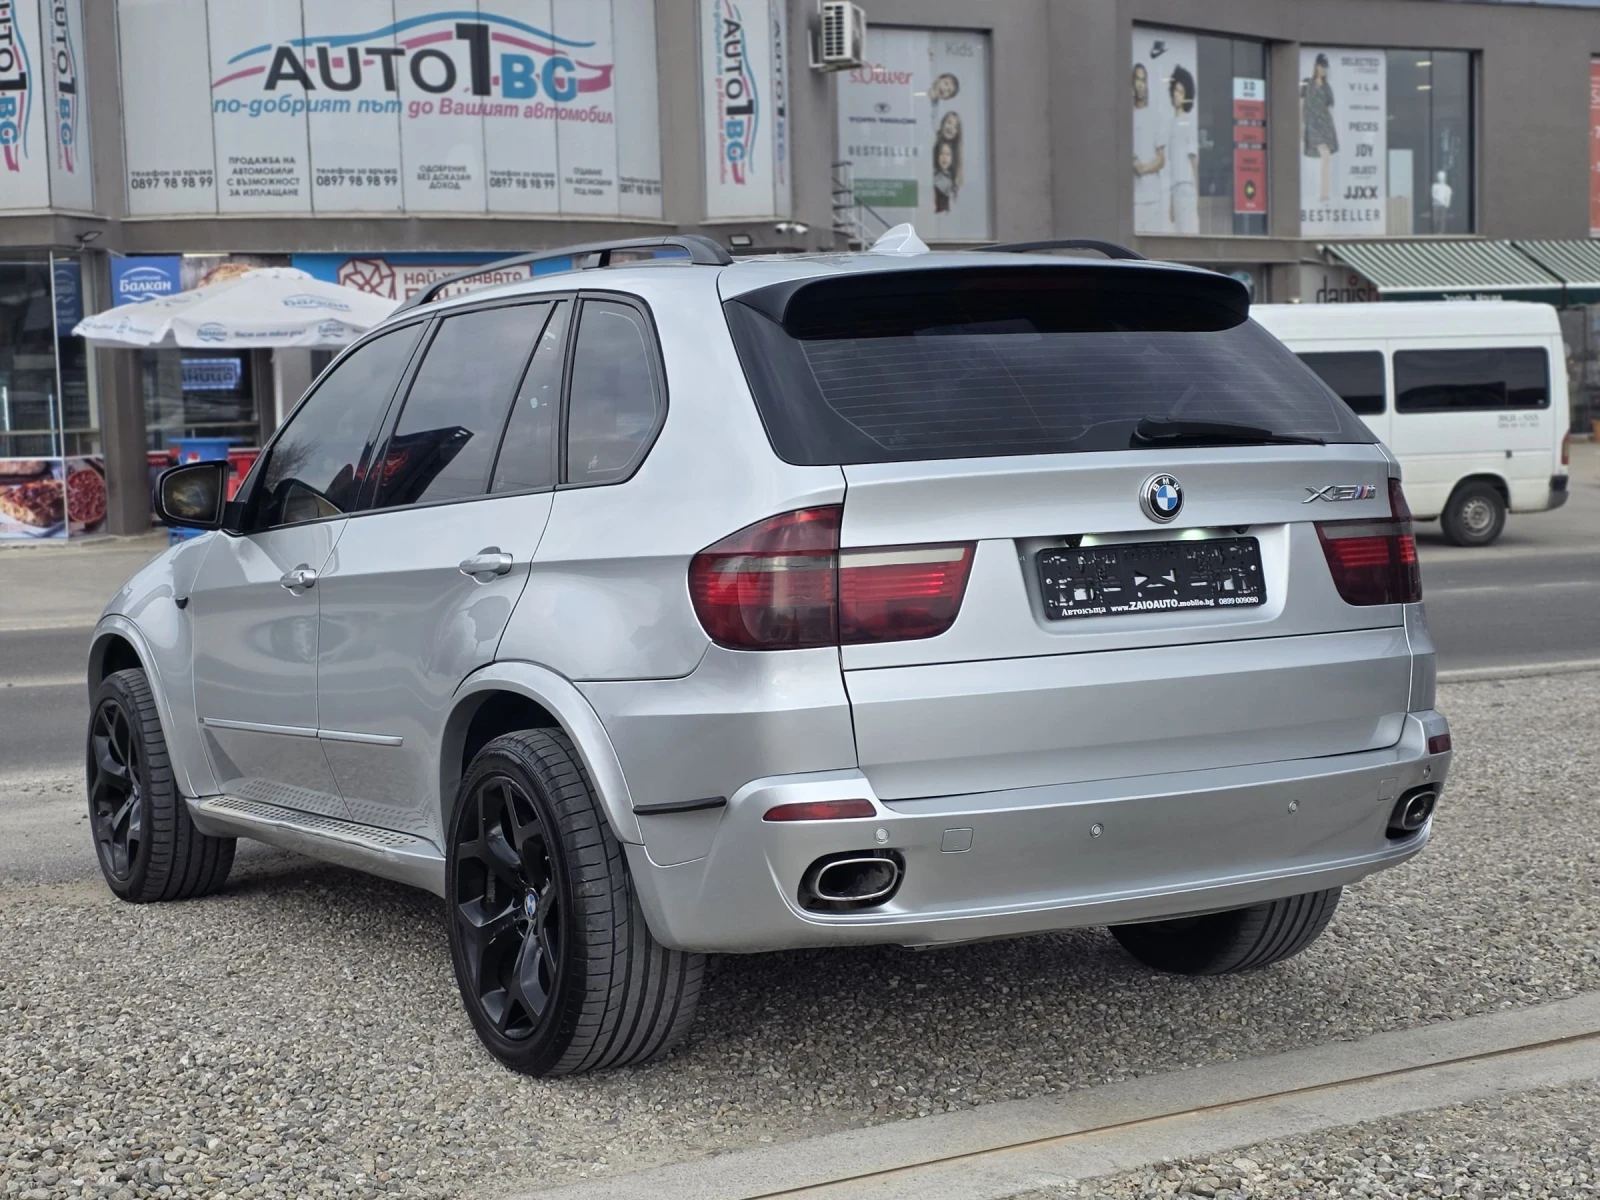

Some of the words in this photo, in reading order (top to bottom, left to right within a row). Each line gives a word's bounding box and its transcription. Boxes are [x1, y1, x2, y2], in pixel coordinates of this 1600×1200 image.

[214, 93, 350, 117] по-добрият
[357, 99, 402, 113] път
[408, 100, 434, 118] до
[439, 98, 519, 118] Вашият
[524, 105, 613, 124] автомобил
[228, 156, 280, 165] ПРОДАЖБА
[283, 156, 296, 164] НА
[232, 167, 294, 175] АВТОМОБИЛИ
[131, 178, 160, 189] 0897
[164, 177, 178, 188] 98
[181, 177, 196, 188] 98
[199, 176, 213, 187] 99
[316, 175, 345, 186] 0897
[349, 175, 363, 186] 98
[366, 175, 380, 186] 98
[384, 175, 397, 186] 99
[229, 188, 240, 196] ЗА
[1300, 209, 1381, 222] BESTSELLER
[120, 279, 172, 292] Балкан
[1153, 478, 1181, 491] BMW
[1061, 606, 1107, 616] Автокъща
